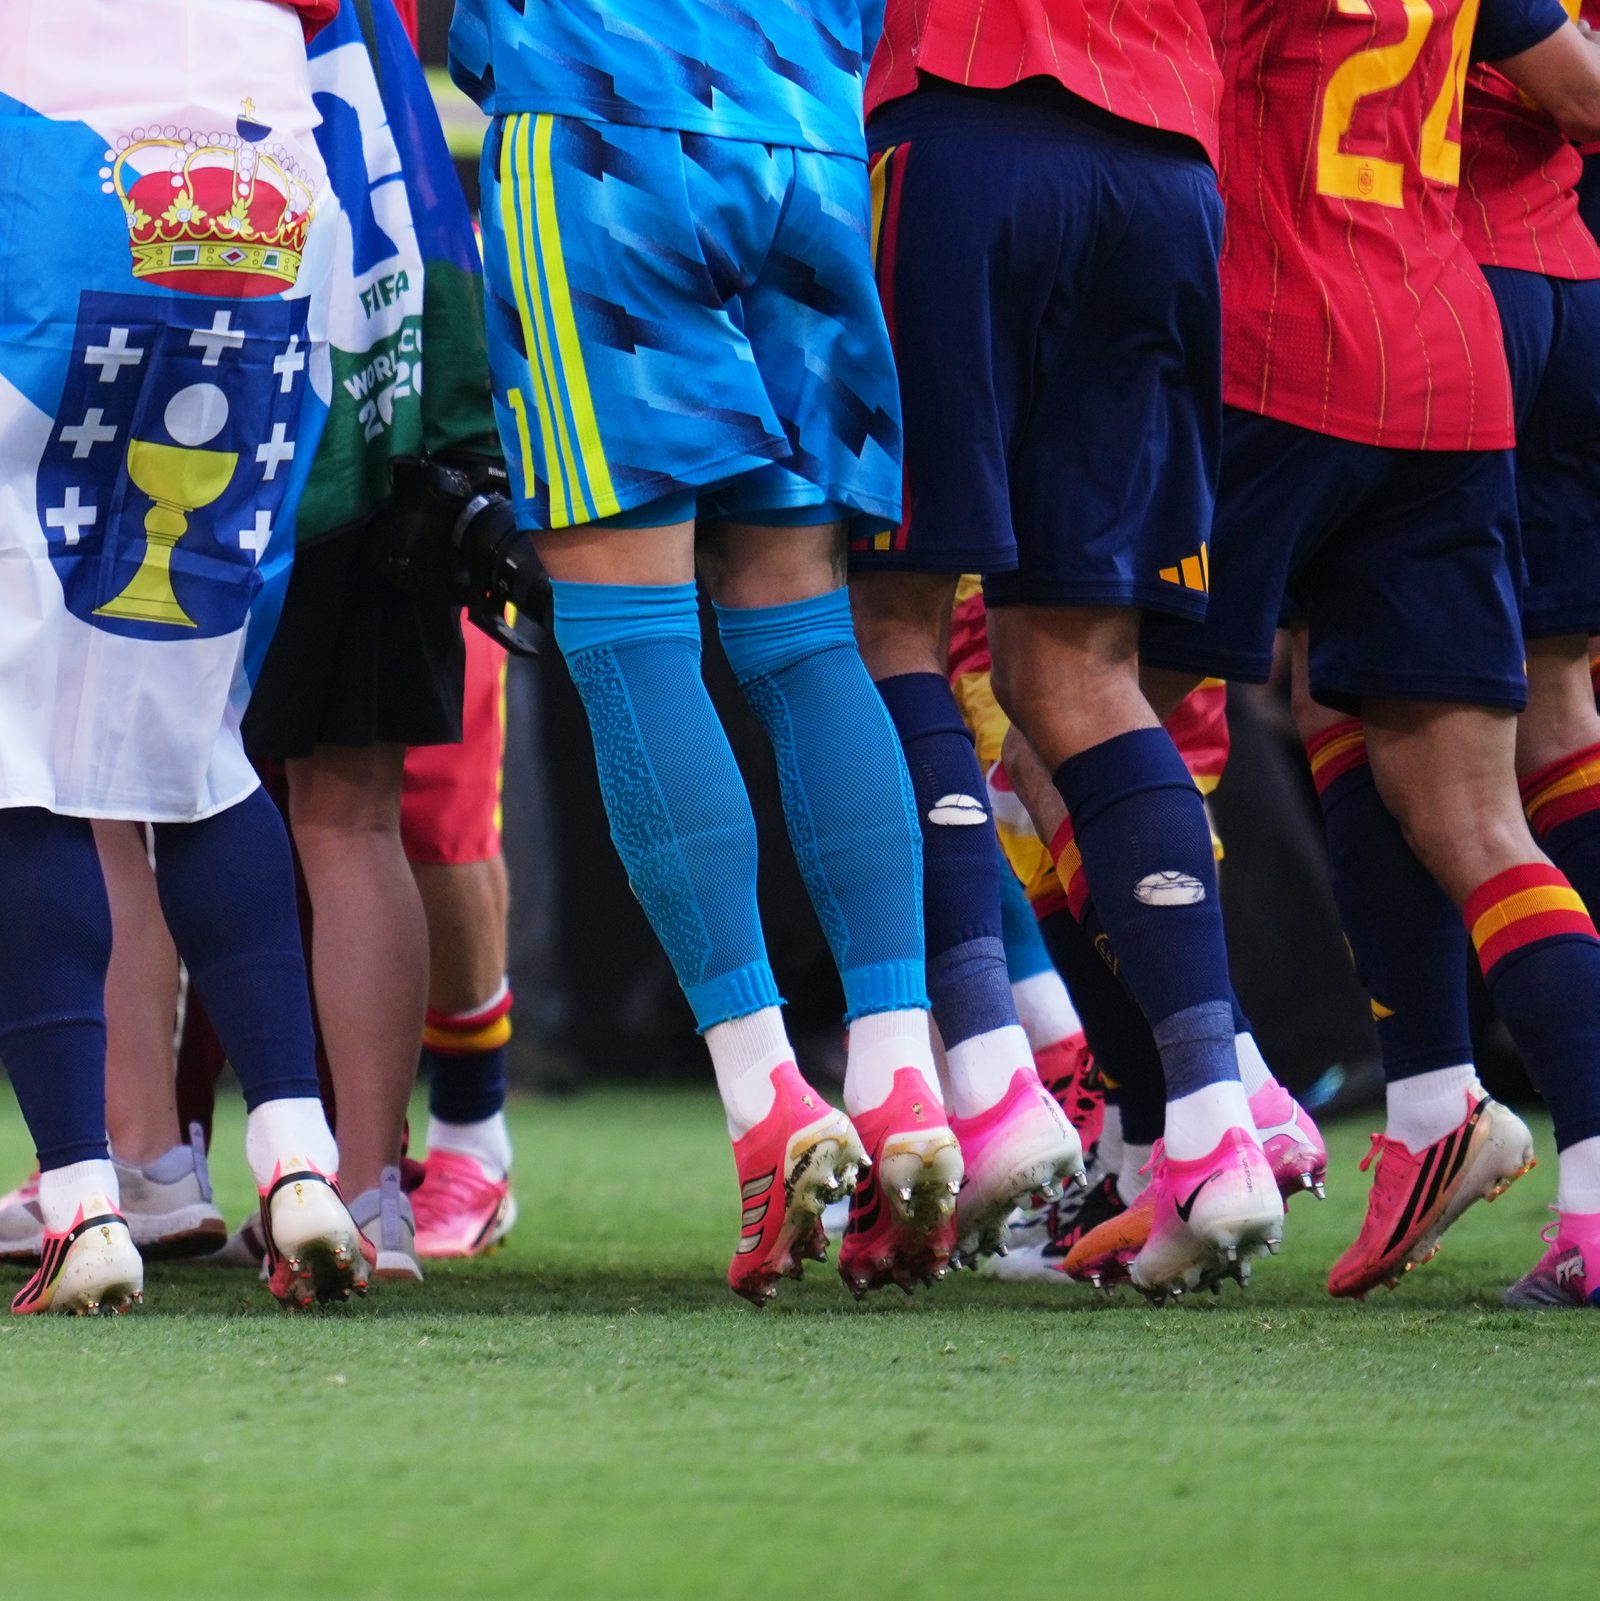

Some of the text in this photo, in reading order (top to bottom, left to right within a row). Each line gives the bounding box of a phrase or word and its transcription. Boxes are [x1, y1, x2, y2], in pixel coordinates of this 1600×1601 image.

[359, 269, 410, 321] FIFA
[343, 343, 401, 401] WORL
[508, 388, 535, 499] 1
